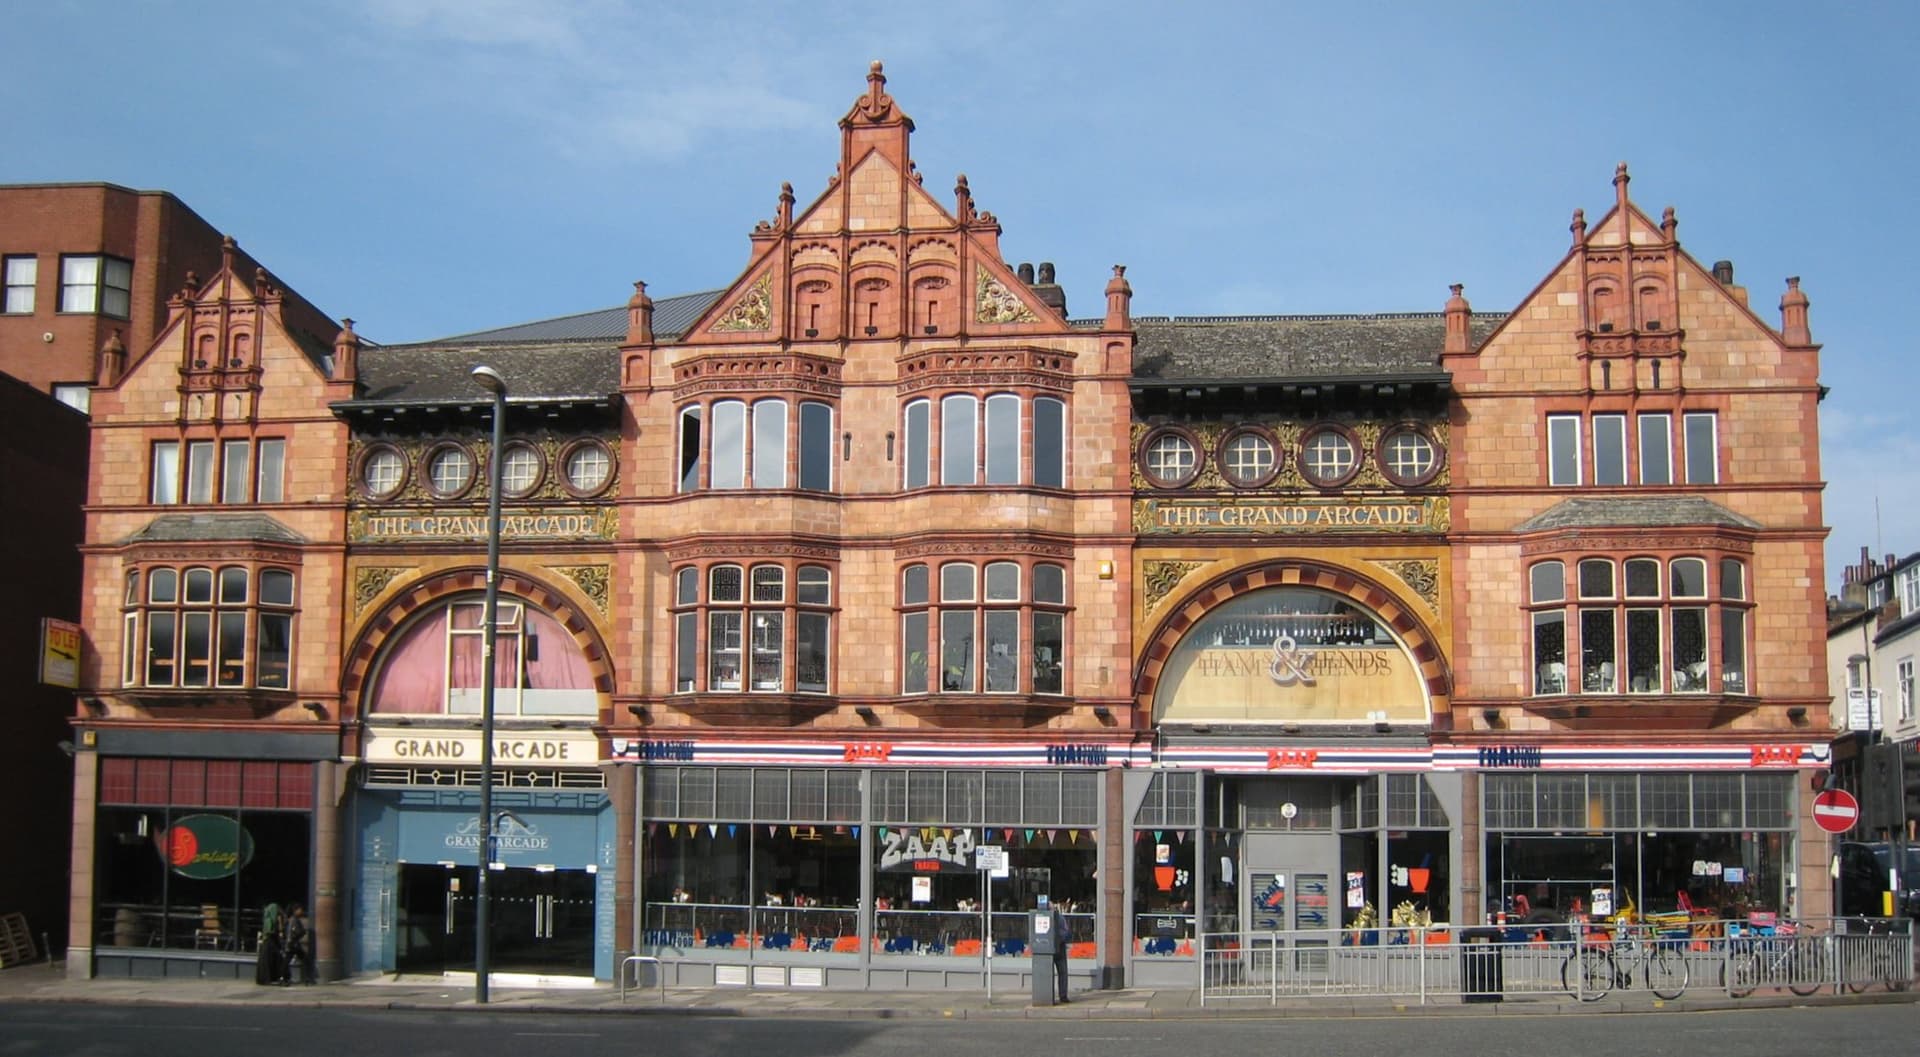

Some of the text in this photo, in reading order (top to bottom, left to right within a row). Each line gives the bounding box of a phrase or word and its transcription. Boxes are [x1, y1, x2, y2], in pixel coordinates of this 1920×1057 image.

[370, 517, 413, 535] THE
[502, 515, 593, 534] ARCADE
[1158, 505, 1419, 525] THE GRAND ARCADE
[49, 629, 80, 650] TO LET
[1270, 636, 1317, 686] &
[394, 739, 465, 758] GRAND
[495, 837, 549, 849] ARCADE
[880, 830, 975, 870] ZAAP
